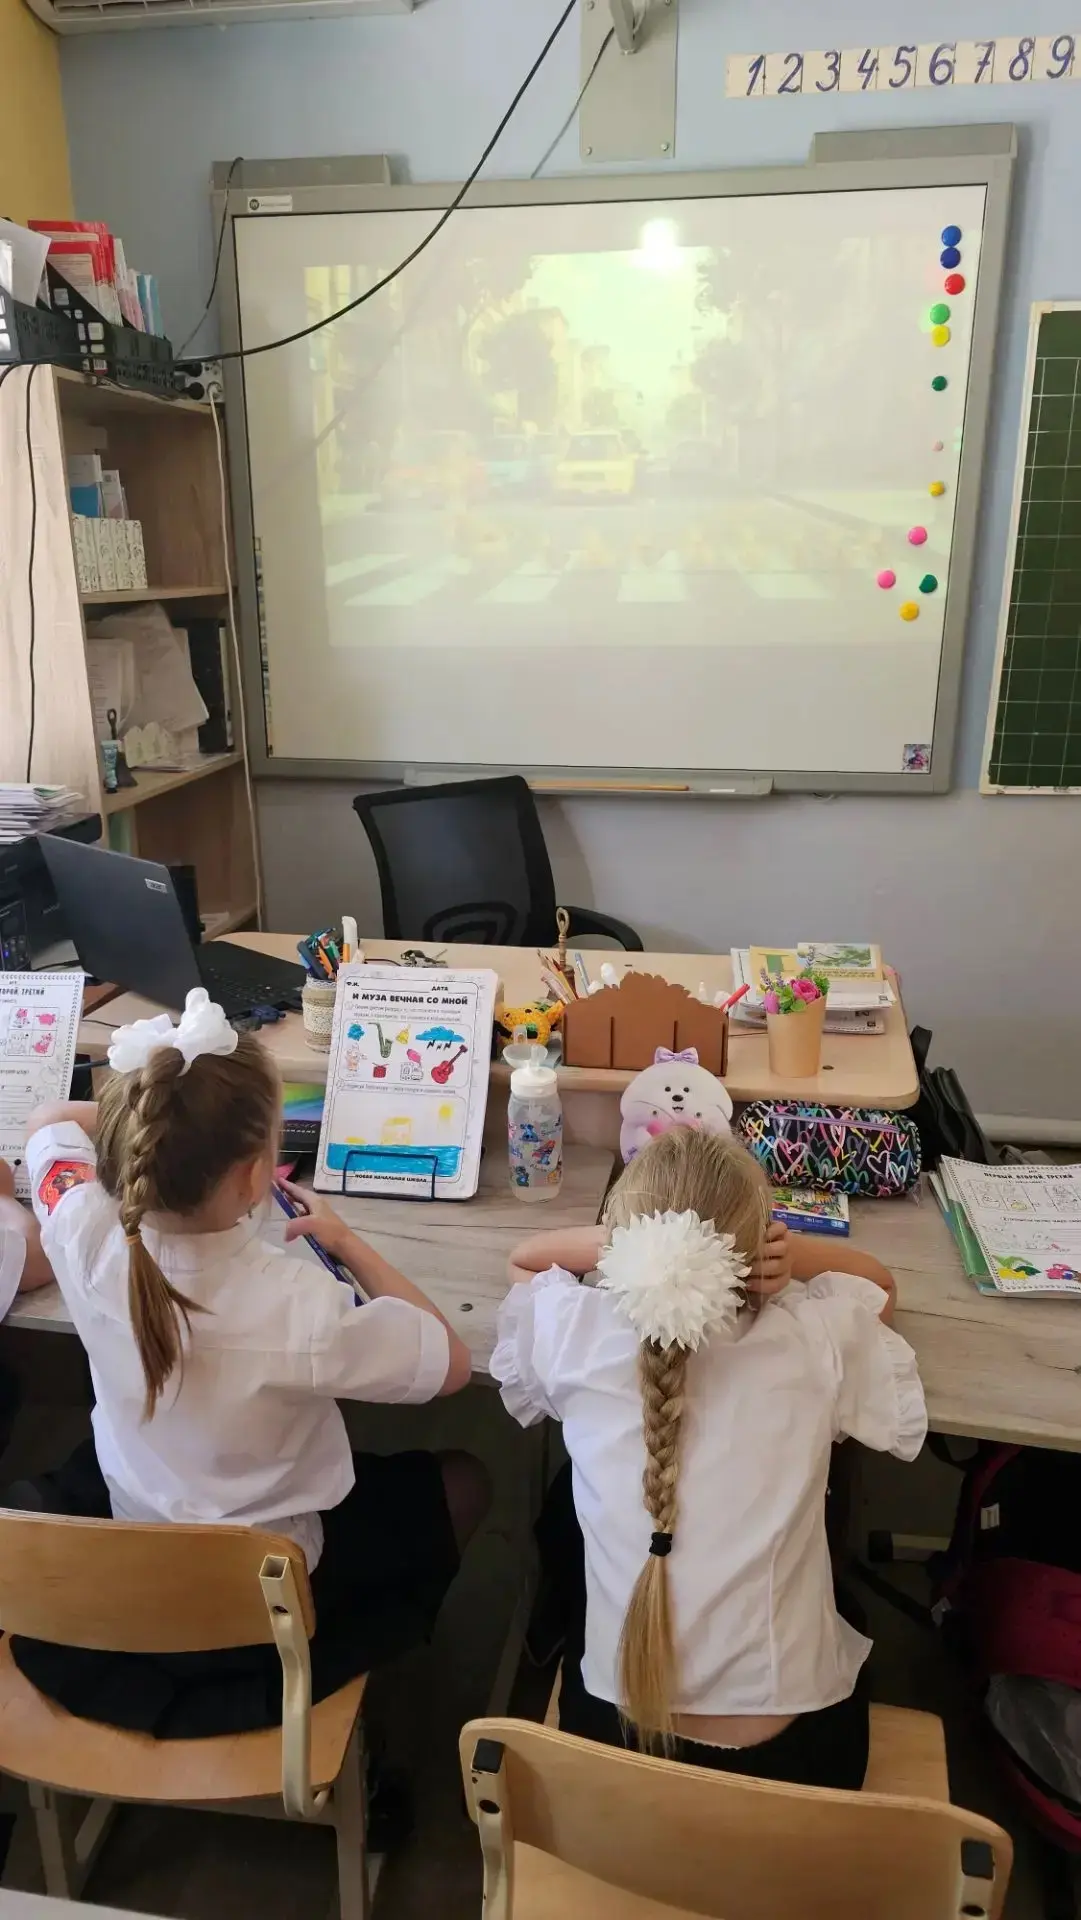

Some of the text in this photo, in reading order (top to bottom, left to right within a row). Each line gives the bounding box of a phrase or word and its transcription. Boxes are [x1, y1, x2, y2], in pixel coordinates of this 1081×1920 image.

[746, 35, 1075, 96] 1 2 3 4 5 6 7 8 9
[361, 993, 387, 1002] МУЗА
[390, 994, 424, 1004] ВЕЧНАЯ
[426, 996, 439, 1004] СО
[441, 995, 468, 1005] МНОЙ
